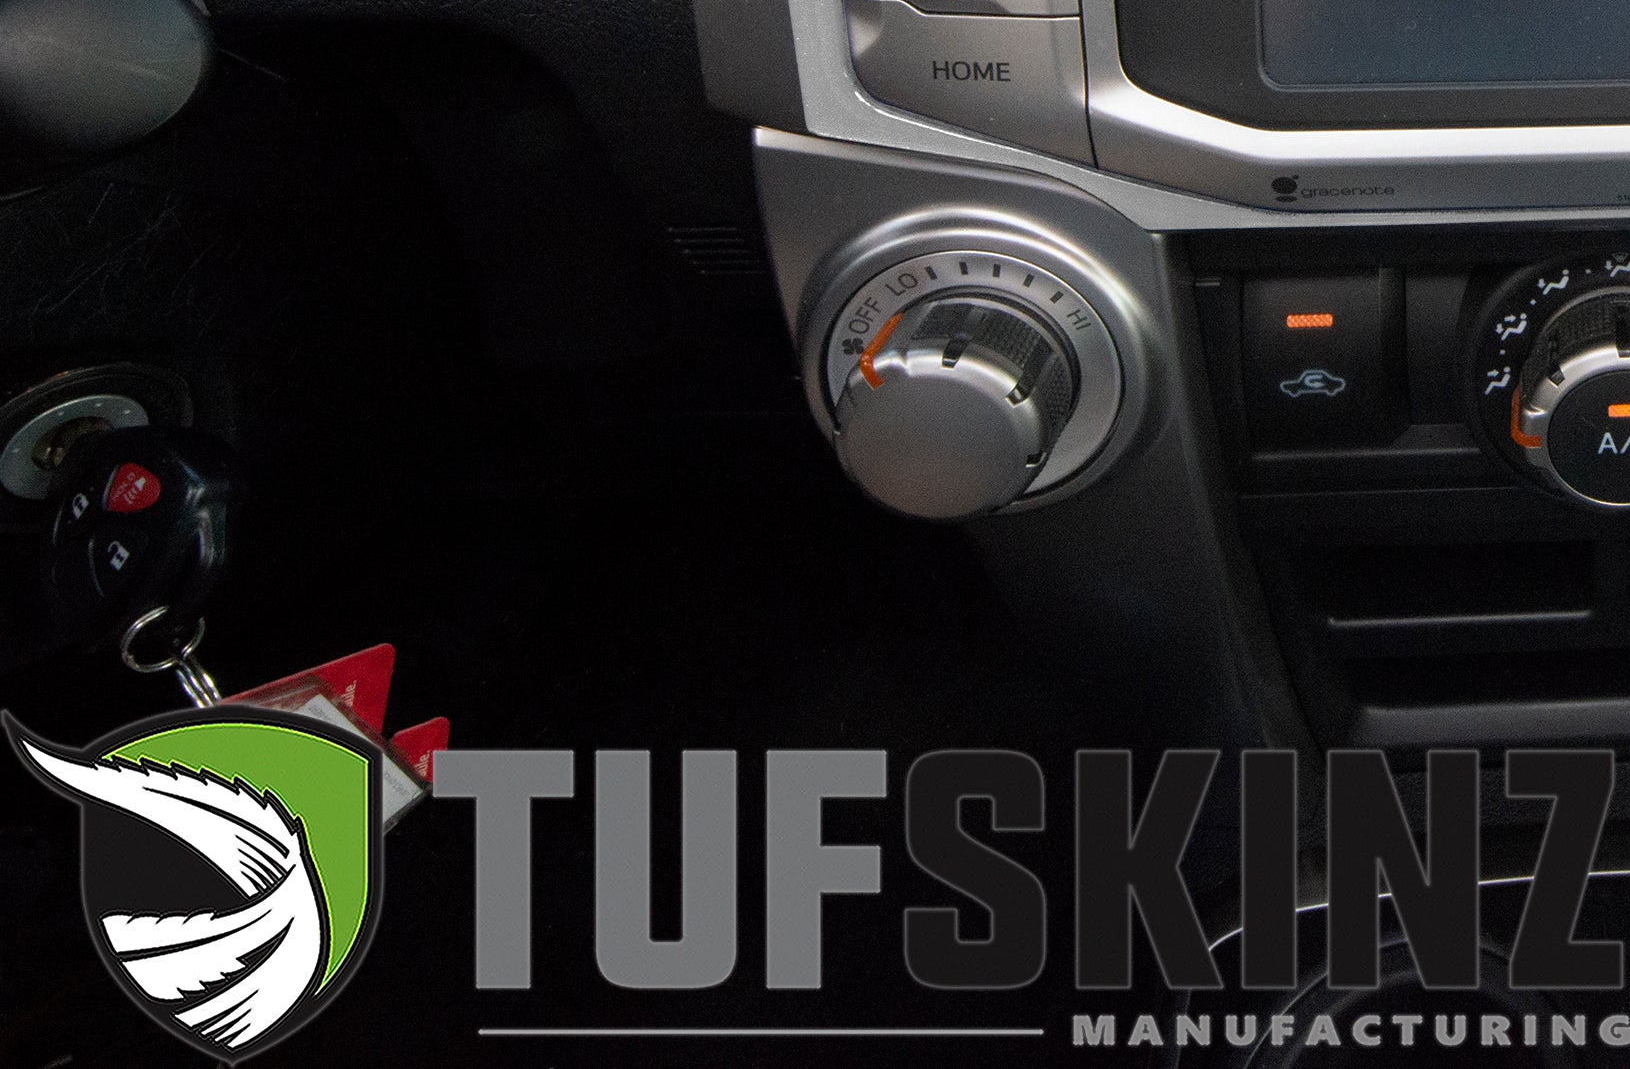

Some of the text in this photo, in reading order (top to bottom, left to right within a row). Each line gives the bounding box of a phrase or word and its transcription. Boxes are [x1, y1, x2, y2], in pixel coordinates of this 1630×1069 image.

[931, 60, 1011, 83] HOME
[1300, 185, 1396, 199] gracenote
[885, 272, 919, 297] LO
[848, 296, 883, 334] OFF
[1066, 308, 1092, 331] HI
